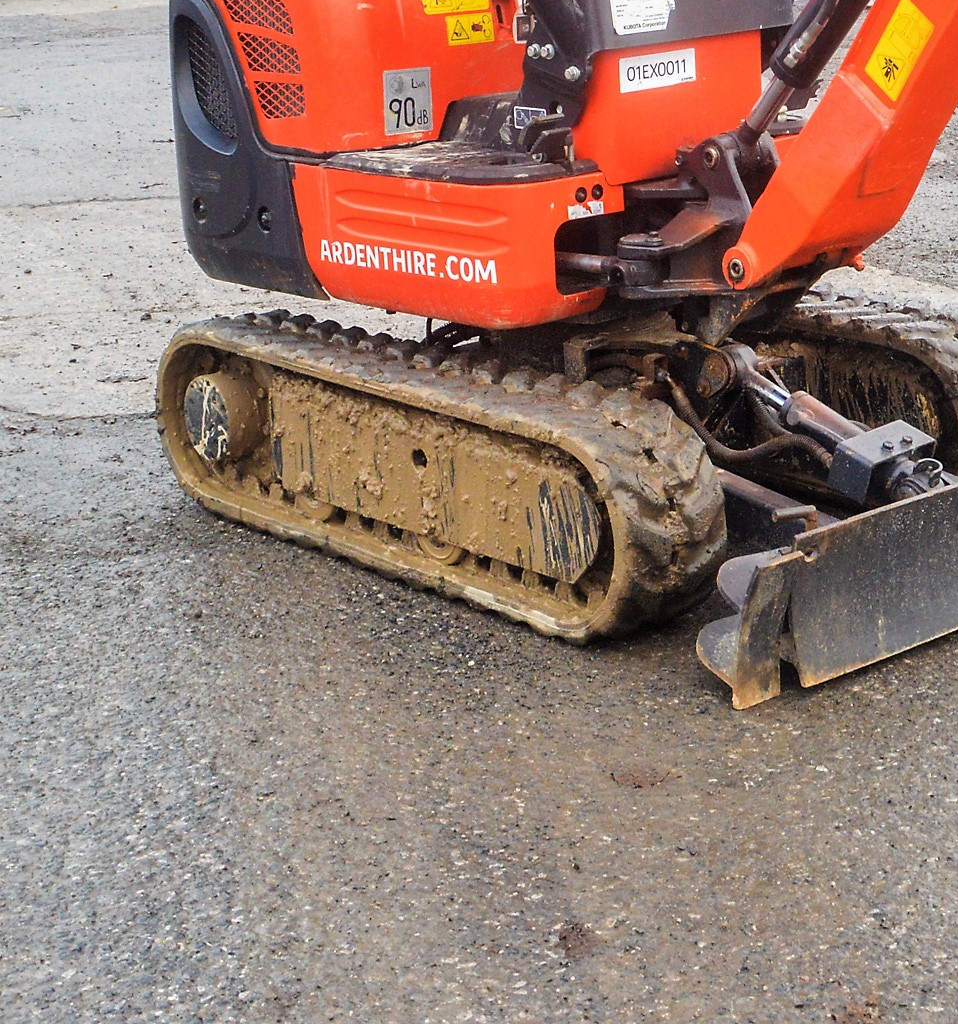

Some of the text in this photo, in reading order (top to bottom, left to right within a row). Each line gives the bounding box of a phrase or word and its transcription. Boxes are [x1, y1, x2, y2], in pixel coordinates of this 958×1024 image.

[623, 21, 667, 31] KUBOTA Corporation
[627, 59, 687, 82] 01EX0011
[389, 97, 429, 129] 90 dB
[320, 239, 498, 285] ARDENTHIRE.COM
